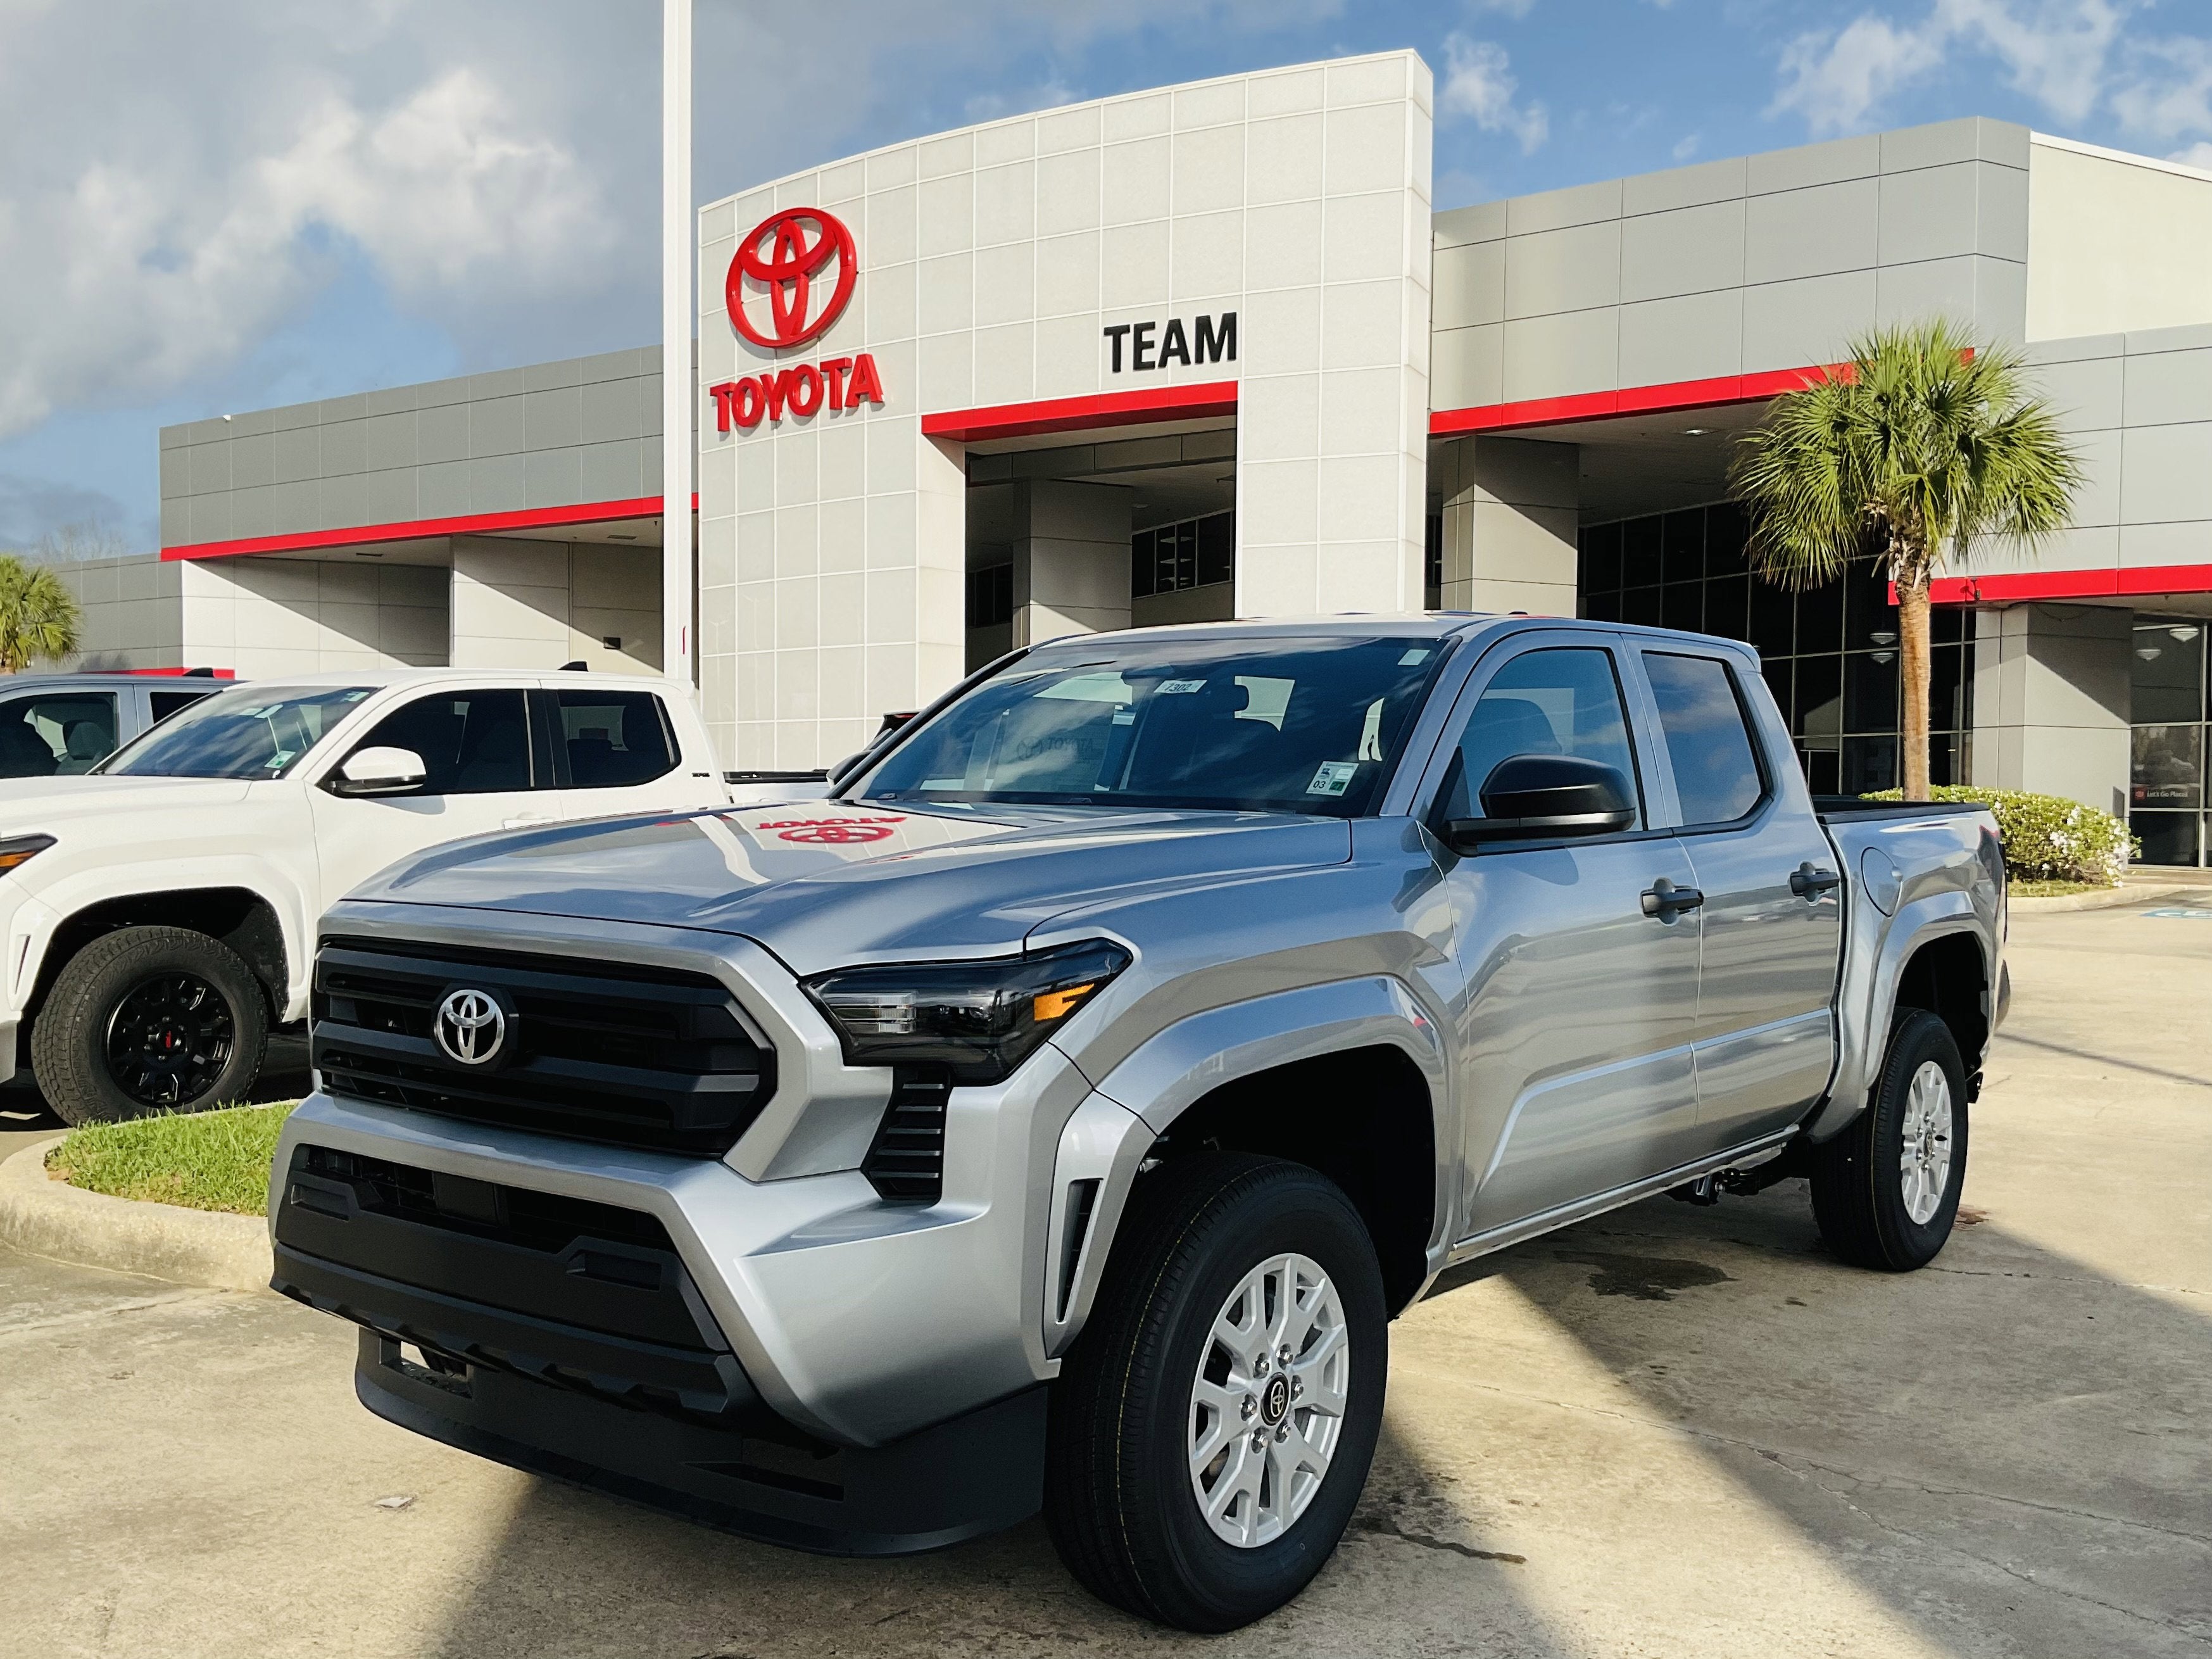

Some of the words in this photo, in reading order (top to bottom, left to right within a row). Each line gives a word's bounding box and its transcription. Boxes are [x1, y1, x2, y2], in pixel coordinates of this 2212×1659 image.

[1103, 312, 1238, 373] TEAM
[710, 354, 884, 432] TOYOTA
[1313, 780, 1326, 789] 03
